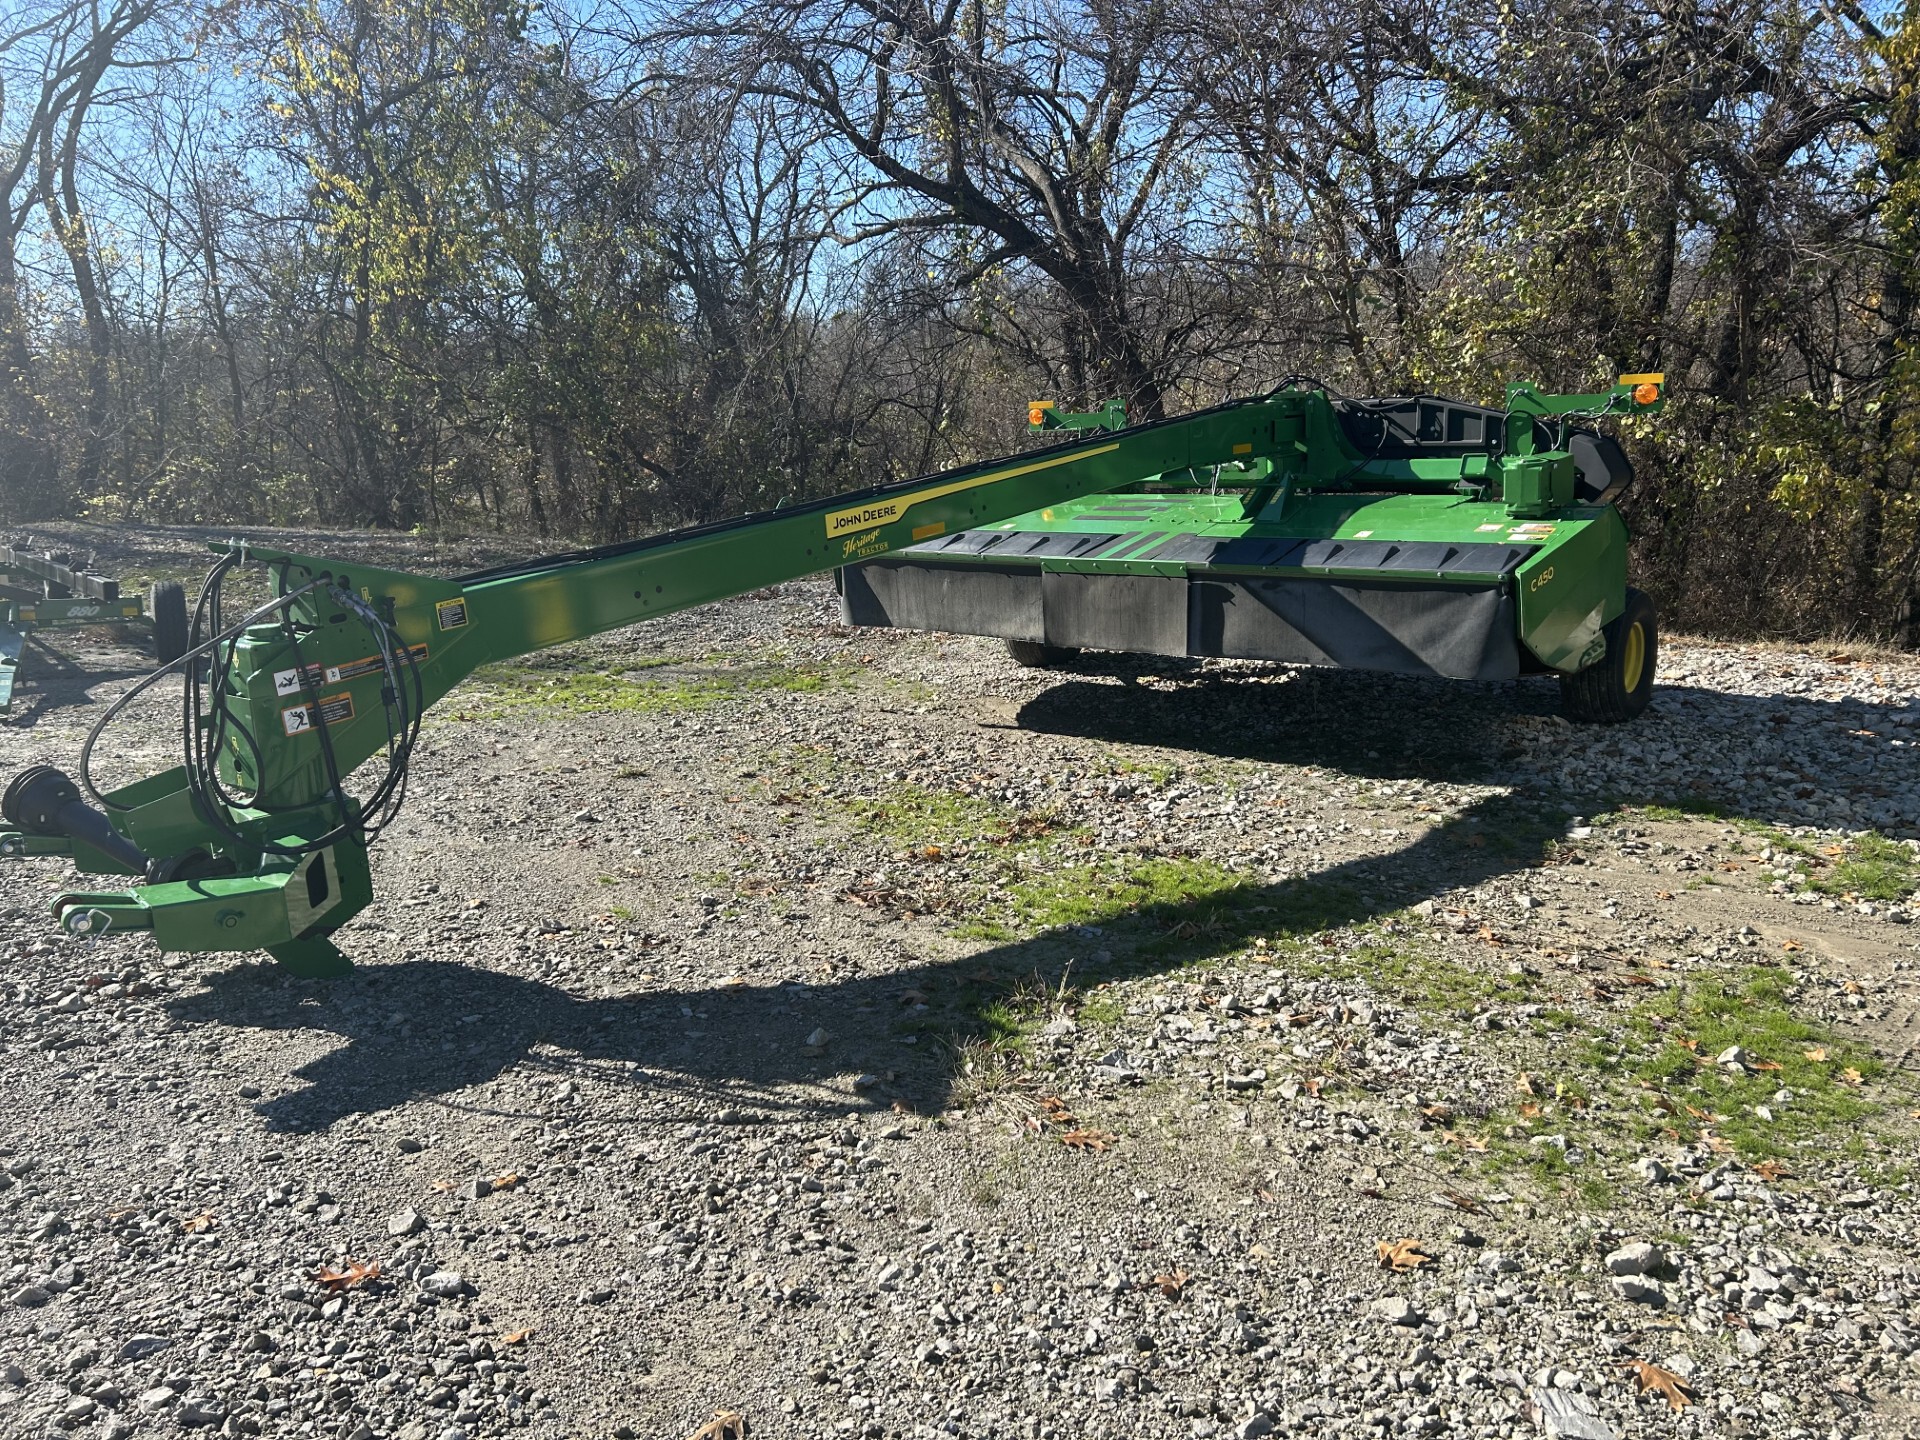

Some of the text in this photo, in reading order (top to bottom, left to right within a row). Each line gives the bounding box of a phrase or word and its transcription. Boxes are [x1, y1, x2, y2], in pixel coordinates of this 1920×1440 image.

[833, 505, 897, 529] JOHN DEERE
[843, 528, 881, 558] Heritage
[857, 542, 889, 557] TRACTOR
[66, 605, 100, 617] 880
